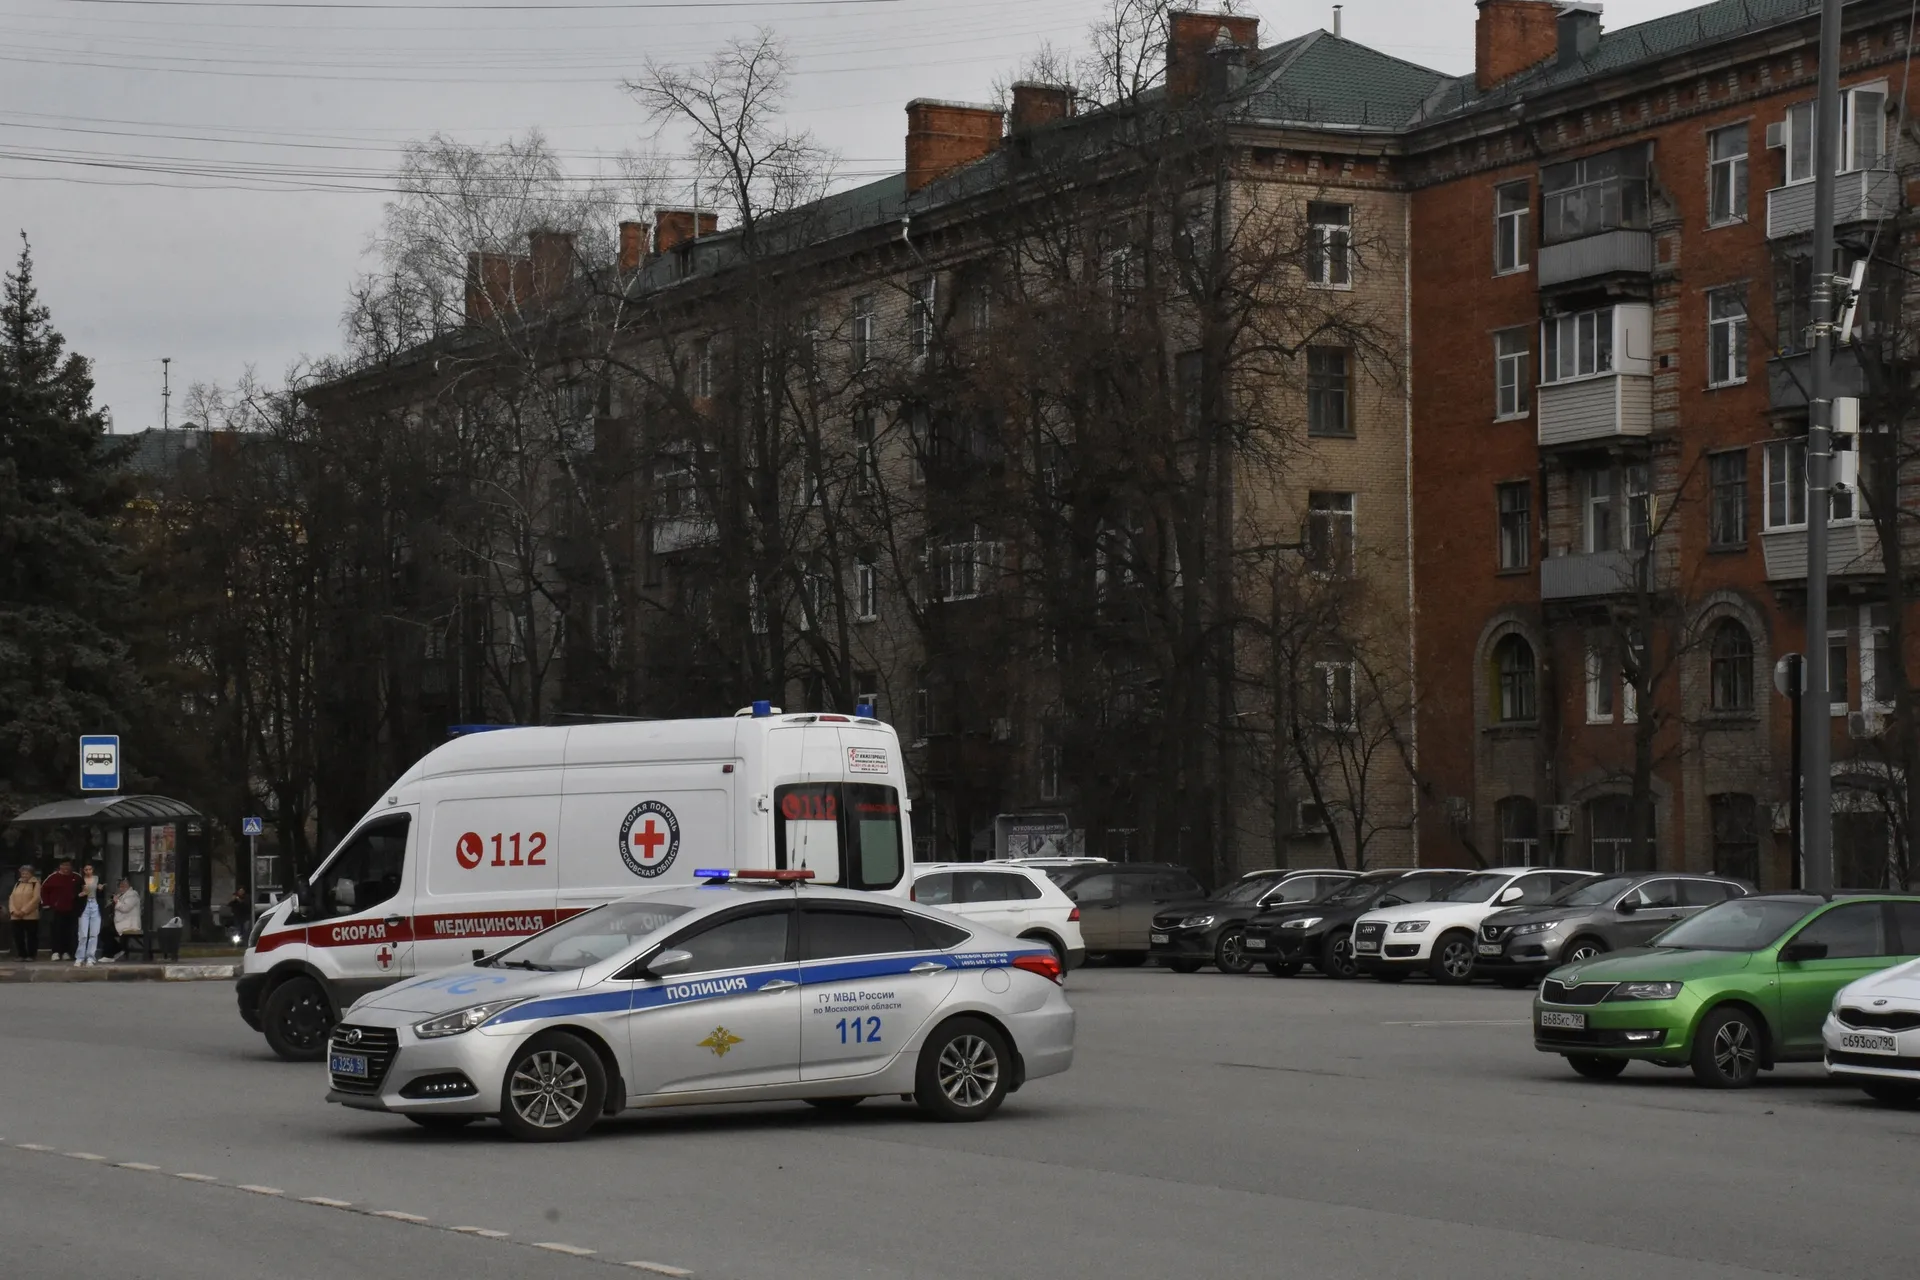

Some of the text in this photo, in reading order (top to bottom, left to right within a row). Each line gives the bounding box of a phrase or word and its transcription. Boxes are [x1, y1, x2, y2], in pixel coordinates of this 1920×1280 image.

[621, 802, 678, 833] СКОРАЯ ПОМОЩЬ
[801, 793, 837, 820] 112
[490, 832, 547, 867] 112
[620, 840, 679, 877] МОСКОВСКАЯ ОБЛАСТЬ
[332, 924, 386, 942] СКОРАЯ
[433, 915, 544, 937] МЕДИЦИНСКАЯ
[666, 977, 748, 1000] ПОЛИЦИЯ
[818, 991, 895, 1003] ГУ МВД России
[825, 1004, 870, 1013] Московской
[871, 1002, 902, 1010] области
[836, 1016, 882, 1044] 112
